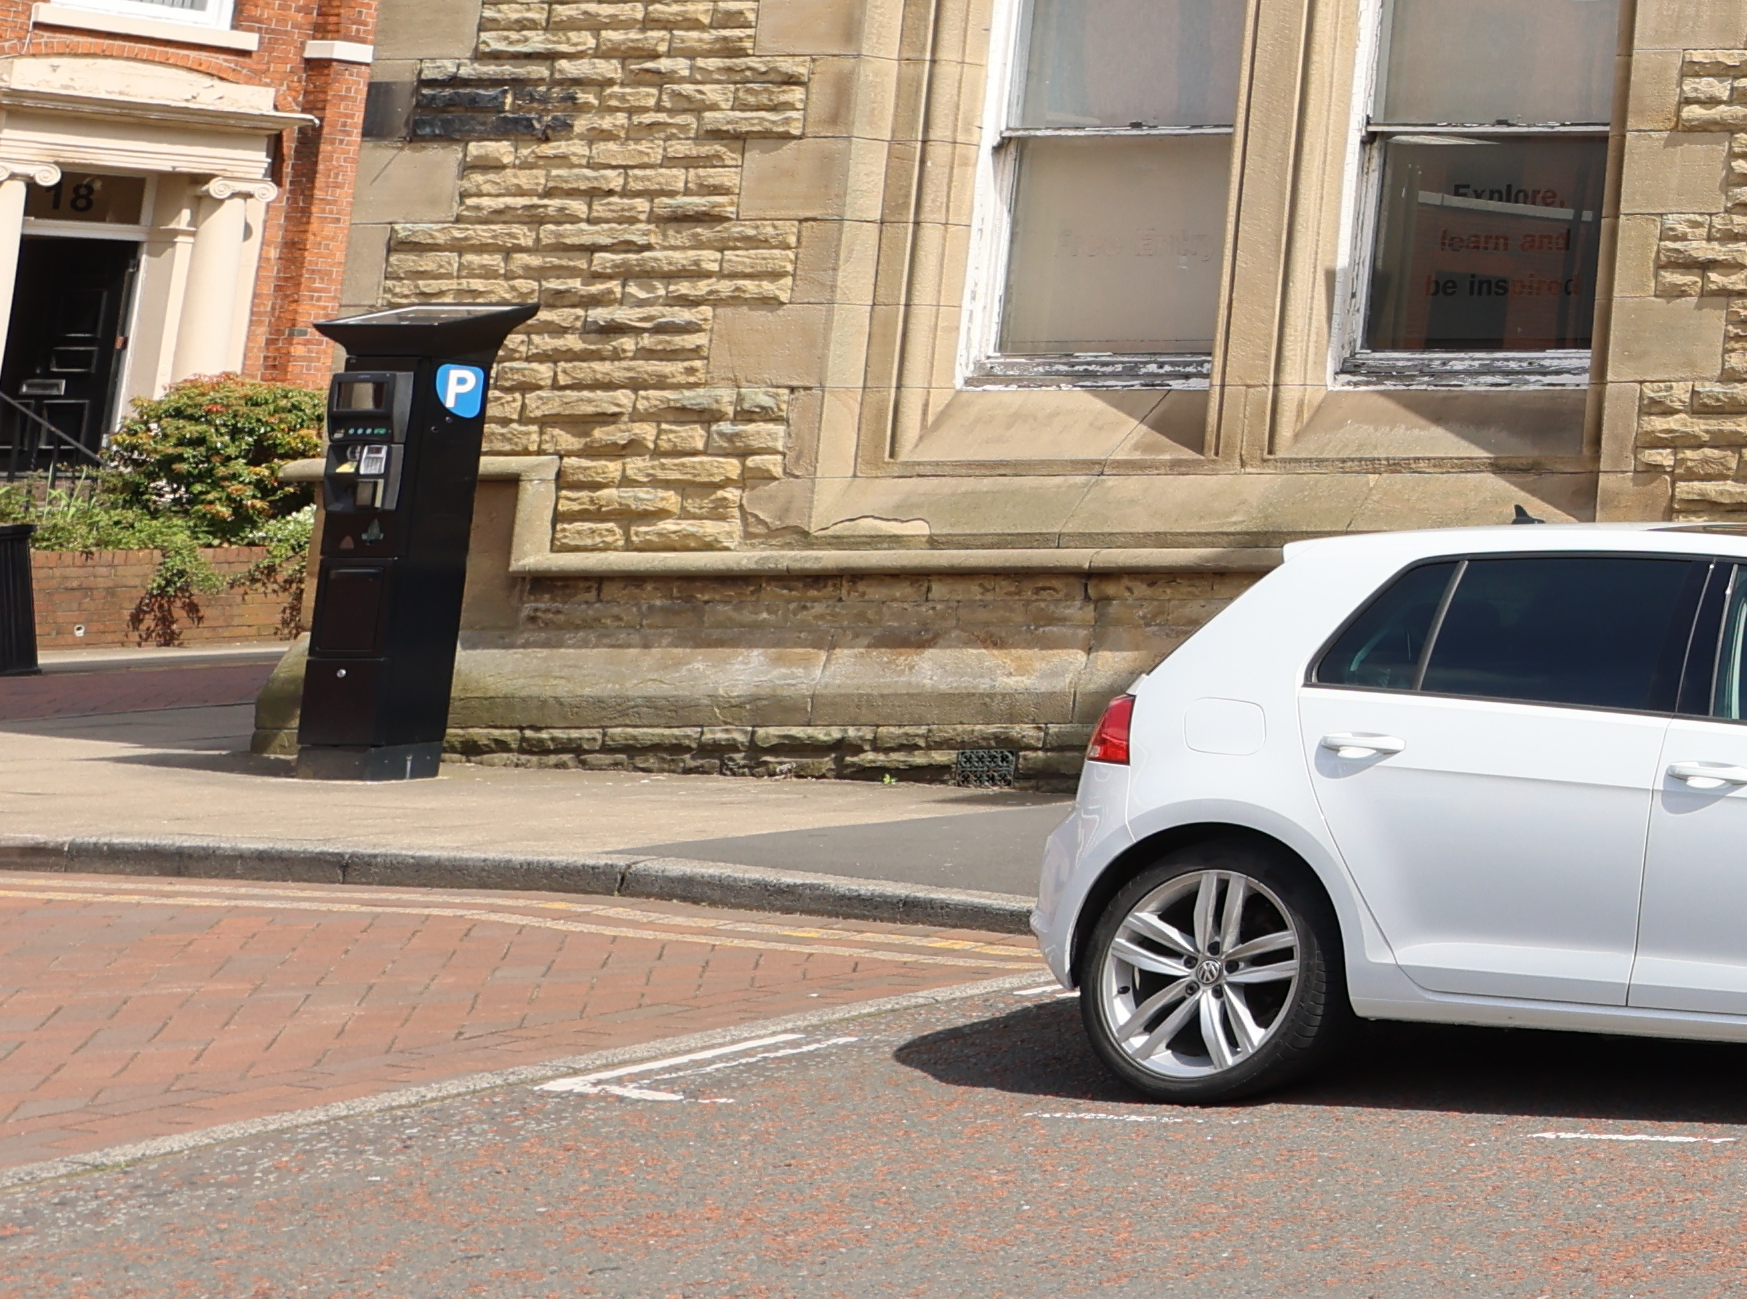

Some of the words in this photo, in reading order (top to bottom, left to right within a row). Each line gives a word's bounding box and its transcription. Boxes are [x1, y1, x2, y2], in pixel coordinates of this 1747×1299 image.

[45, 183, 94, 212] 18
[1440, 228, 1509, 251] learn
[1520, 228, 1571, 251] and
[1425, 274, 1457, 296] be
[1469, 273, 1582, 300] inspired
[445, 369, 477, 408] P
